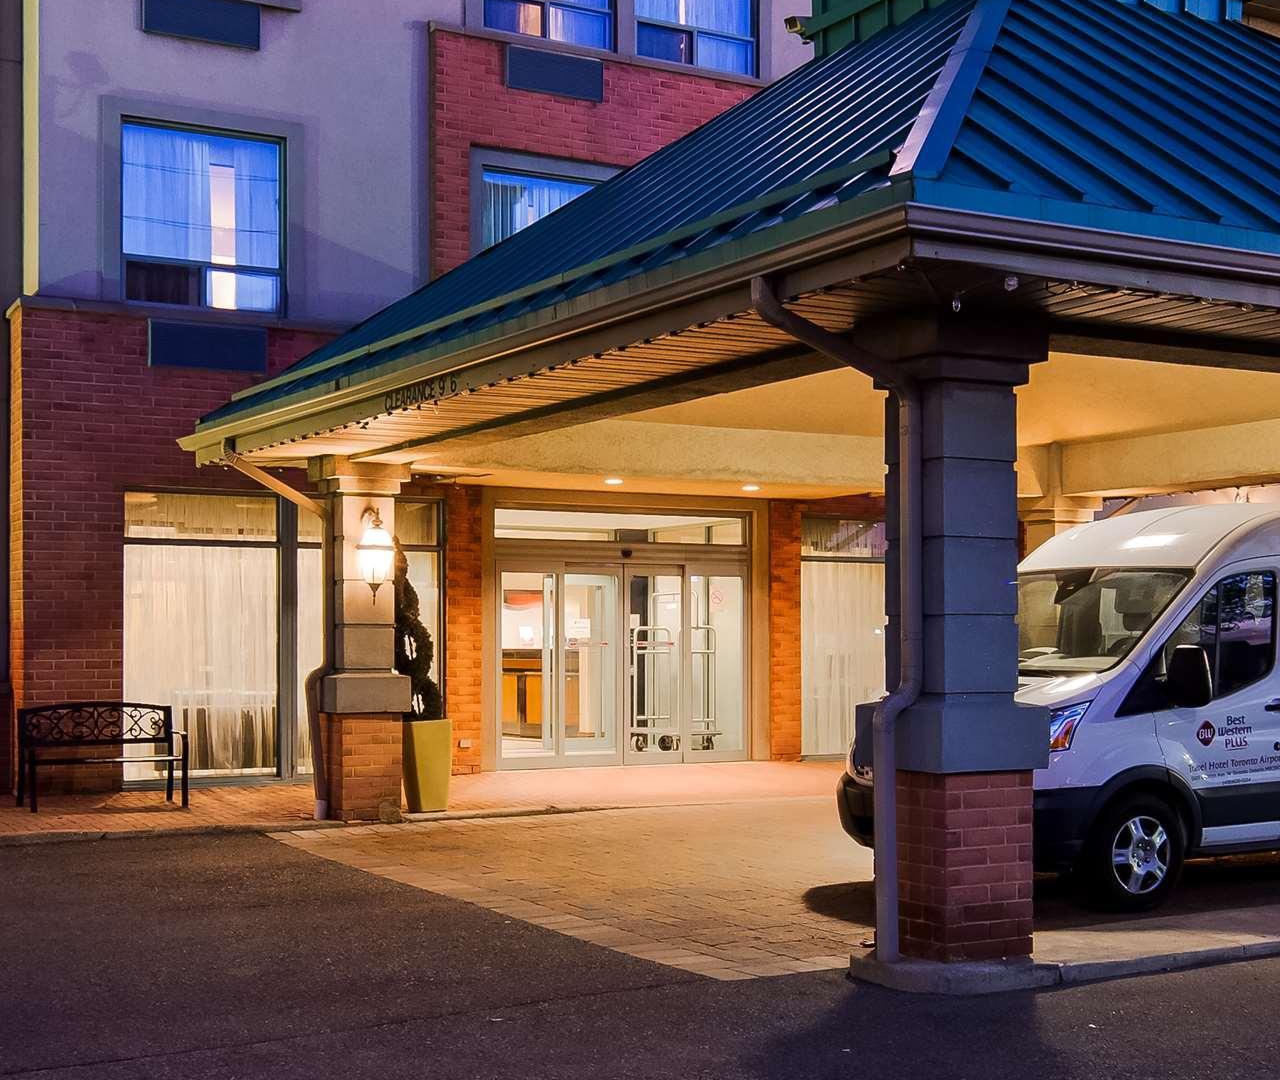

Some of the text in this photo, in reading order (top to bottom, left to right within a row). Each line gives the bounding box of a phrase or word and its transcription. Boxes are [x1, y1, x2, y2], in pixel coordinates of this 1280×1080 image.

[384, 381, 435, 411] CLEARANCE
[1226, 715, 1246, 726] Best
[1199, 727, 1214, 739] BW
[1218, 726, 1252, 736] Western
[1208, 760, 1229, 771] Hotel
[1231, 757, 1258, 767] Toronto
